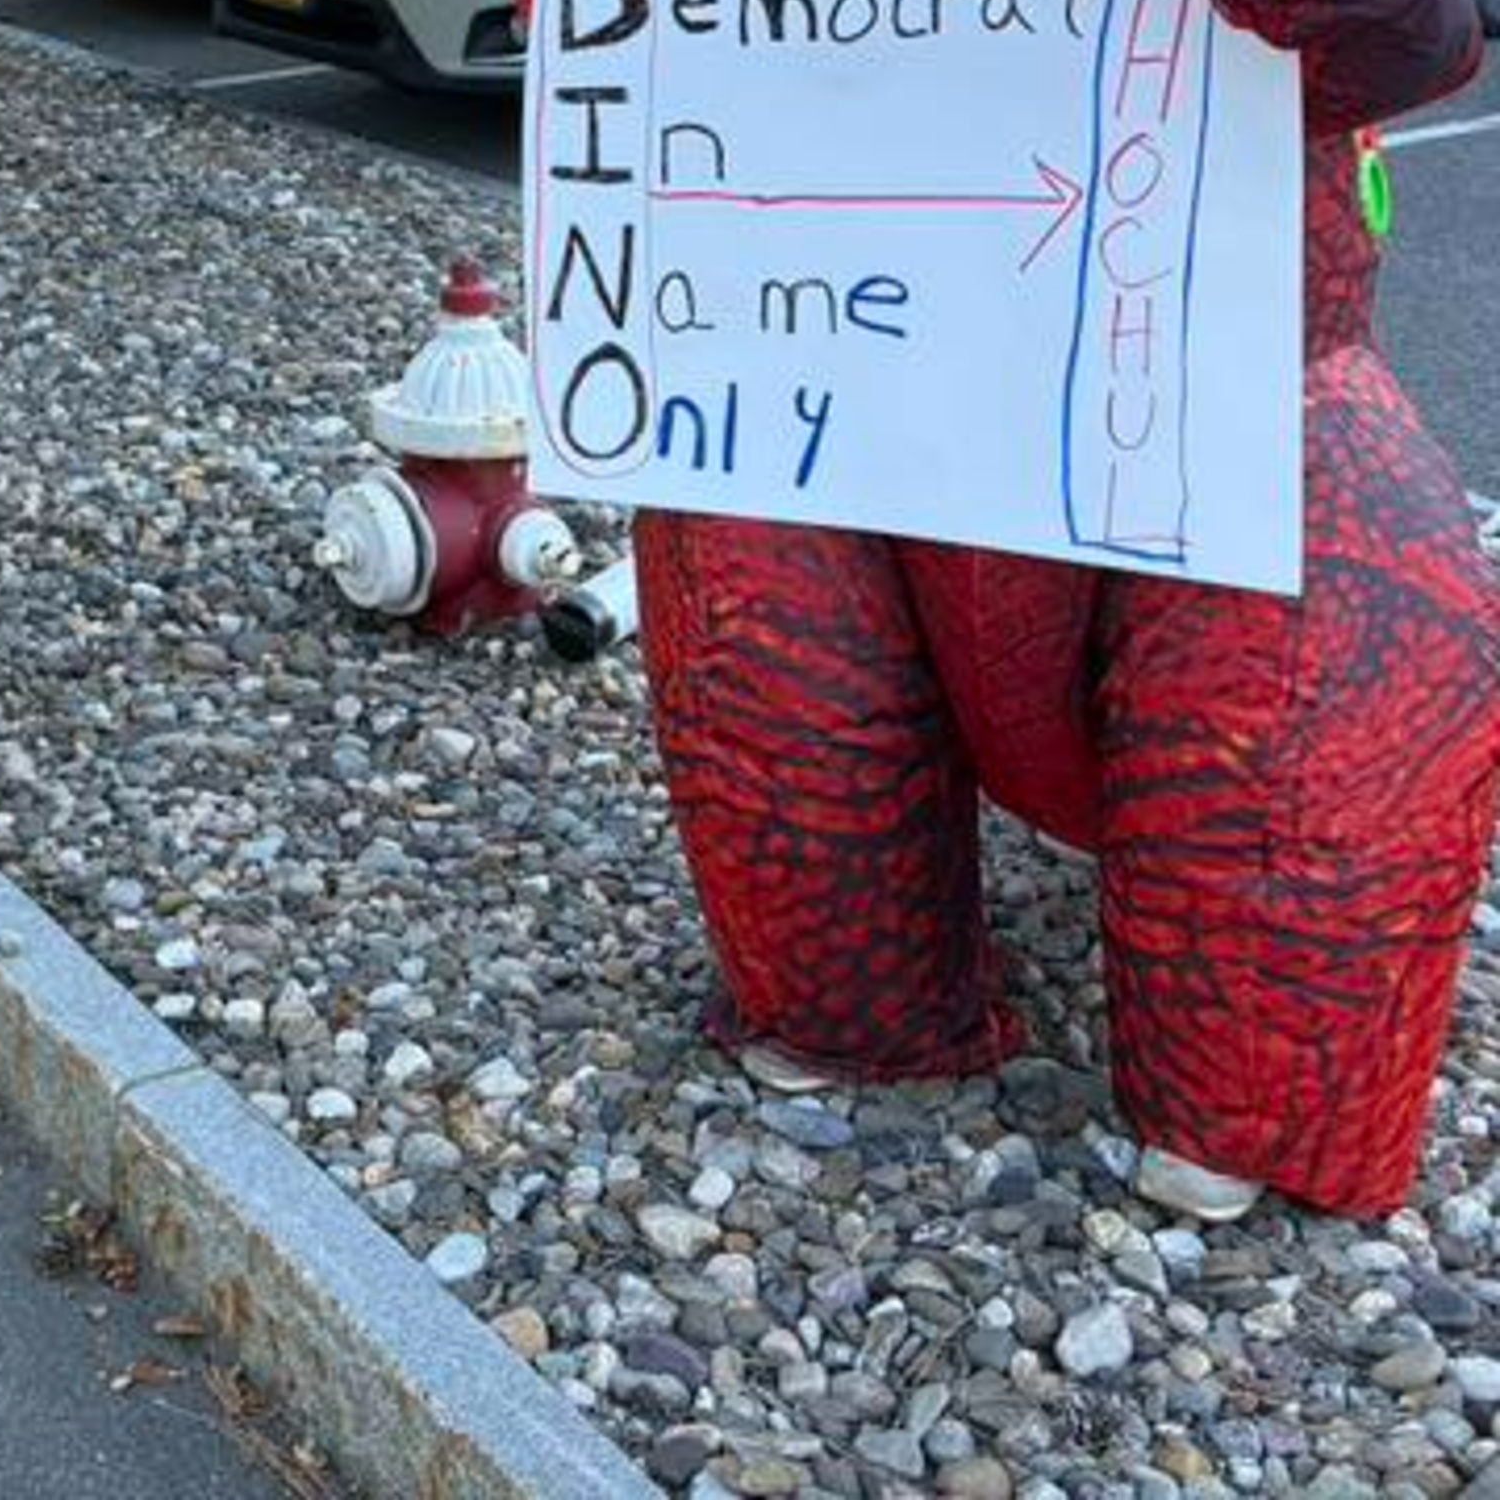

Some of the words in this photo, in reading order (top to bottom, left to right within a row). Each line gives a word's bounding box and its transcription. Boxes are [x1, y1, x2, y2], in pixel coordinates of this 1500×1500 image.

[549, 86, 726, 184] In
[546, 224, 909, 338] Name
[560, 342, 832, 488] Only
